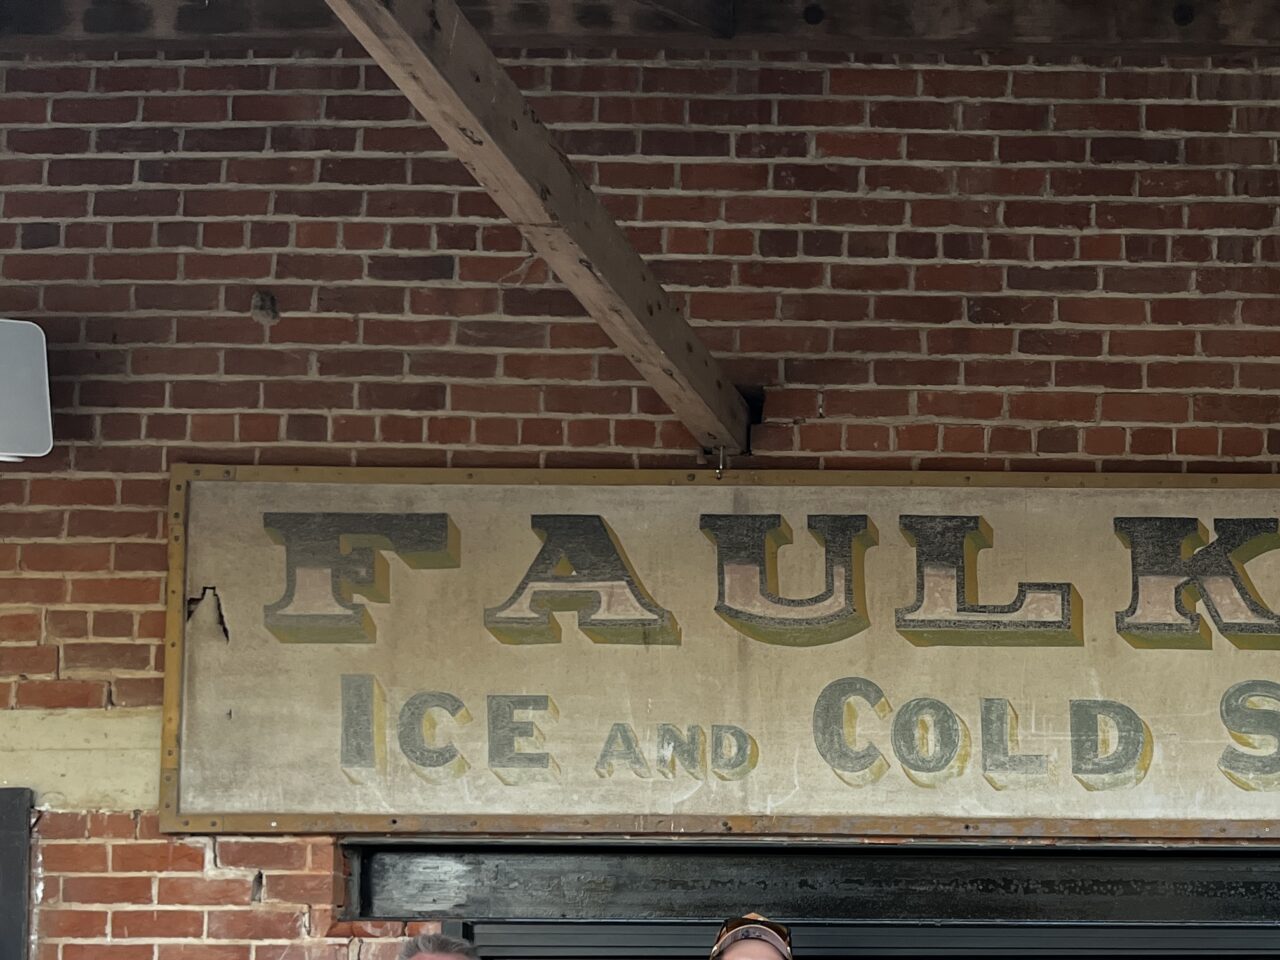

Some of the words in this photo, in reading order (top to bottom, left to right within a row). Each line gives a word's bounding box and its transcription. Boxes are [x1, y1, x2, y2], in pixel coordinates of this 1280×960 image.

[340, 673, 561, 785] ICE
[595, 722, 759, 781] AND
[813, 676, 1154, 792] COLD
